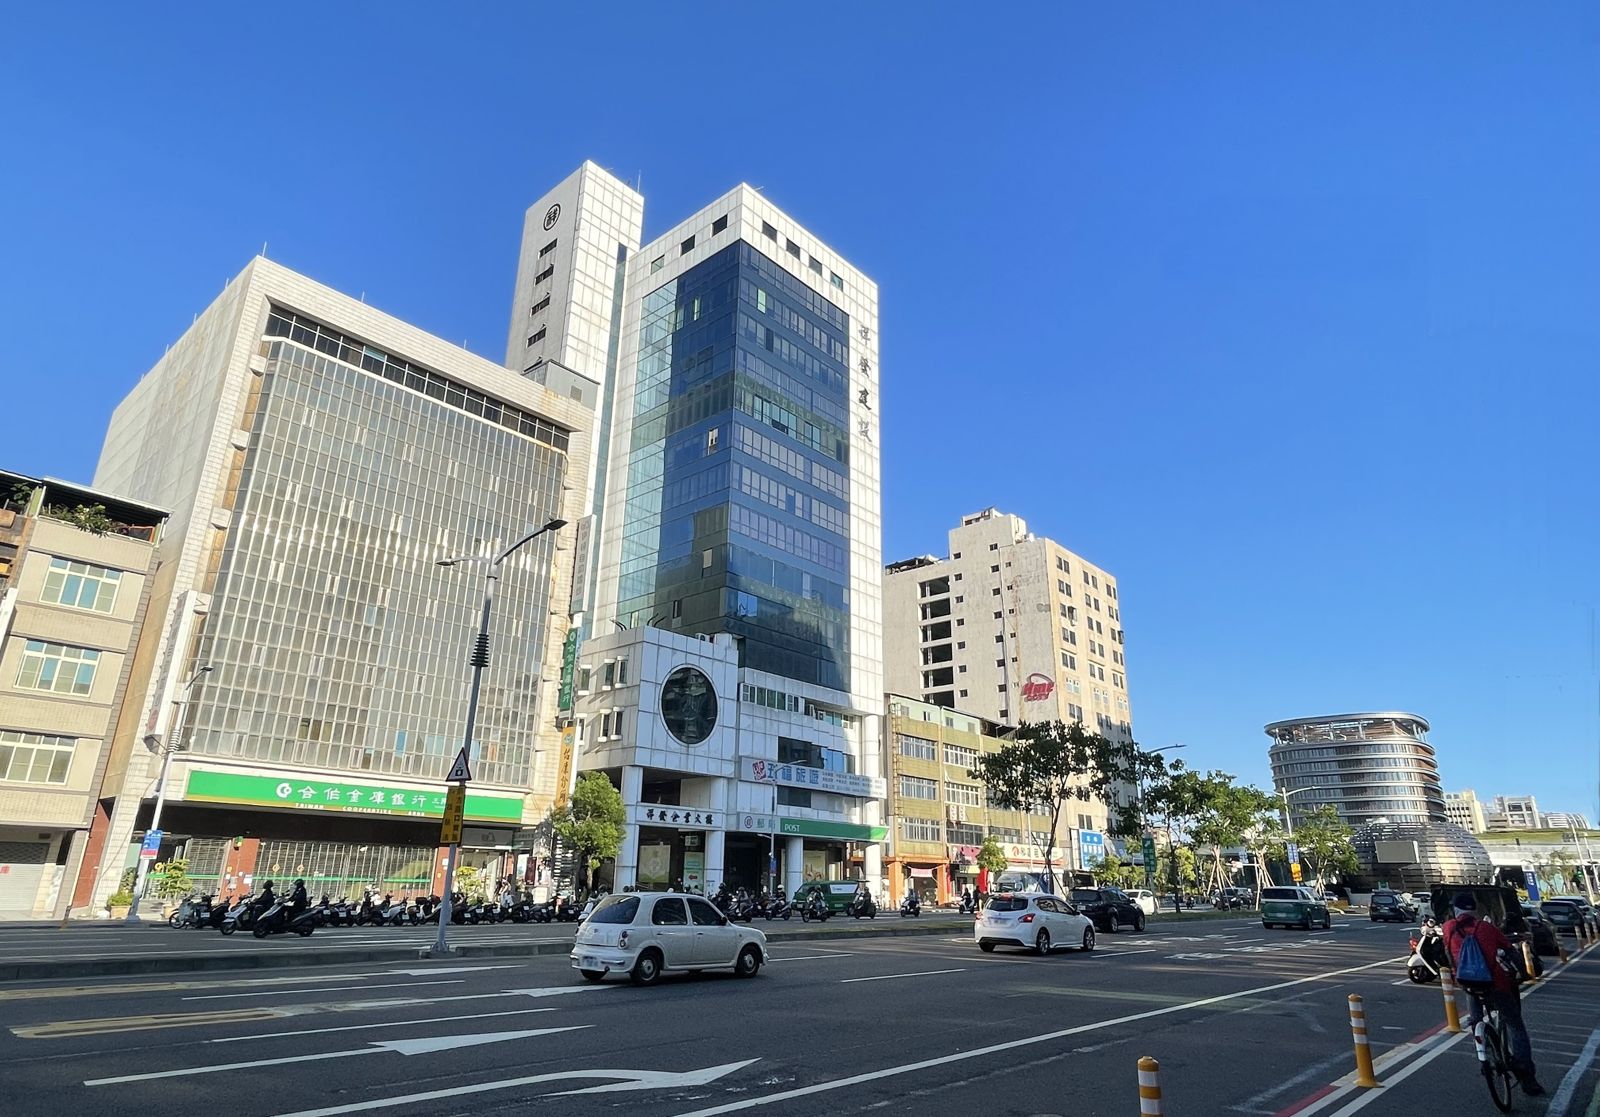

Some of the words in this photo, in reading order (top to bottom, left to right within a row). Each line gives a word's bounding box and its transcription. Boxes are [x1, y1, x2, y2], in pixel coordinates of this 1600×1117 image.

[562, 643, 576, 703] 合作金庫銀行
[297, 785, 427, 808] 合作金庫銀行
[646, 808, 713, 825] 祥發企業大樓
[784, 824, 801, 832] POST
